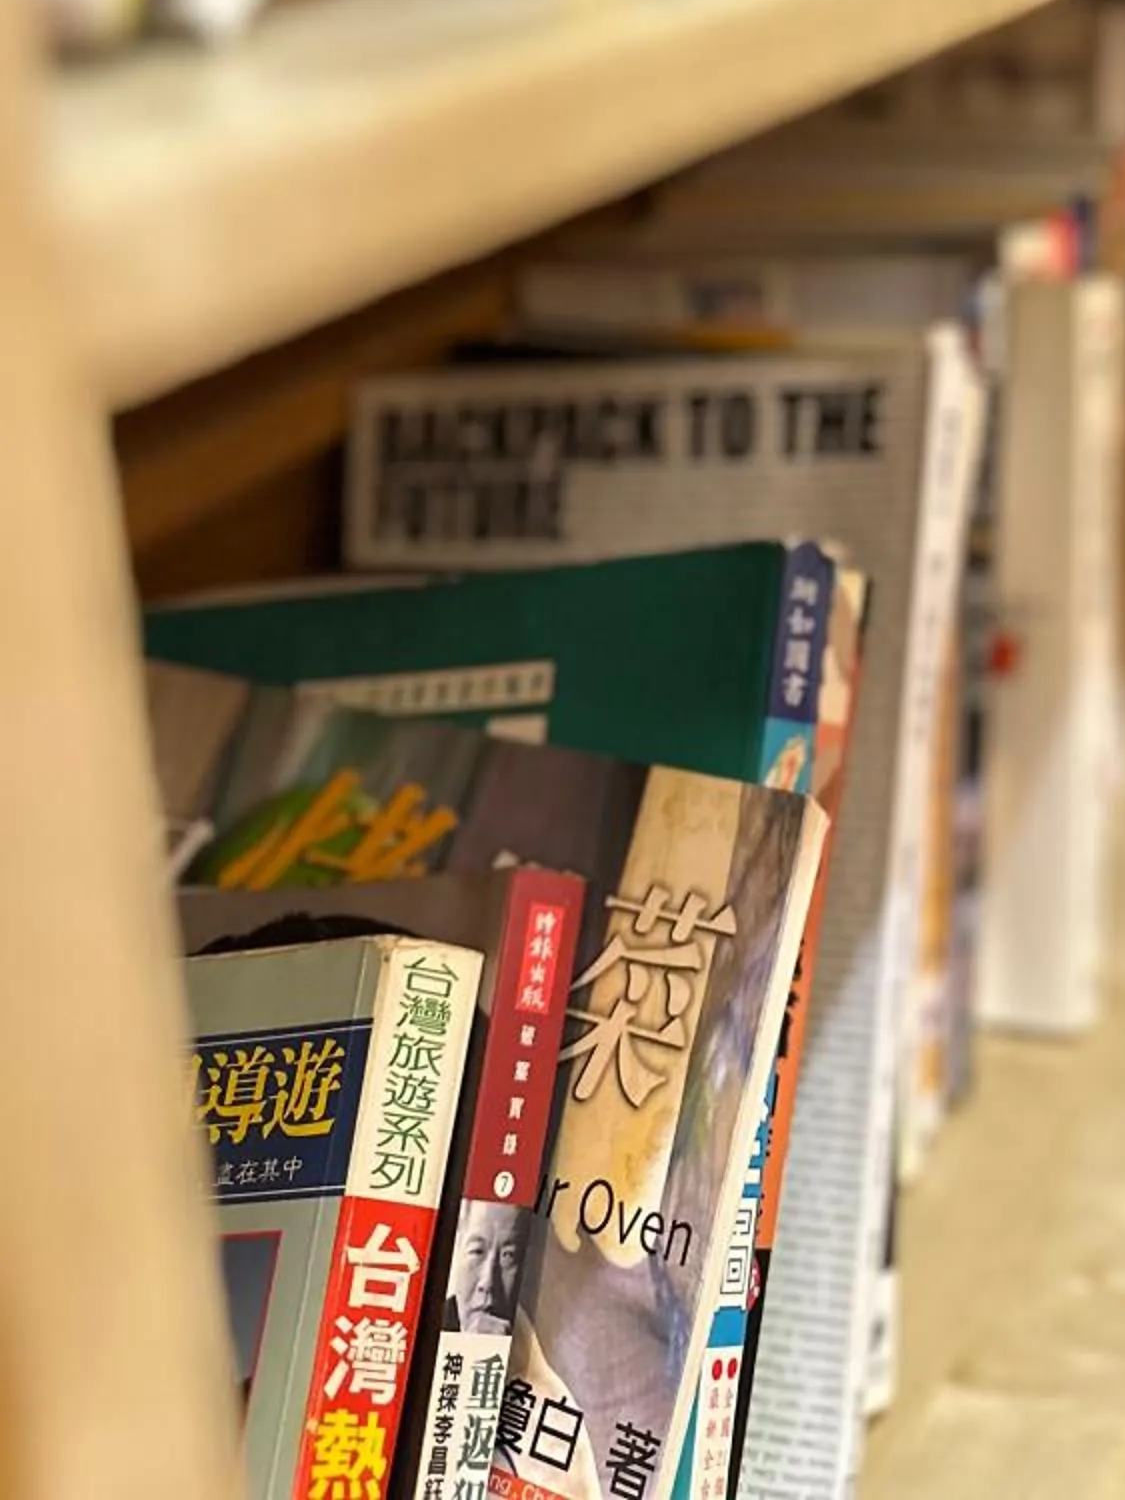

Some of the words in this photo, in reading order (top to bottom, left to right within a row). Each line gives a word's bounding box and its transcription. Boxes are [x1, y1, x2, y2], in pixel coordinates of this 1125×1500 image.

[378, 397, 664, 465] BACKPACK
[687, 386, 757, 461] TO
[778, 382, 886, 459] THE
[193, 1037, 346, 1145] 導遊
[369, 956, 460, 1196] 台灣旅遊系列
[579, 1178, 693, 1268] Oven
[605, 1420, 662, 1500] 著
